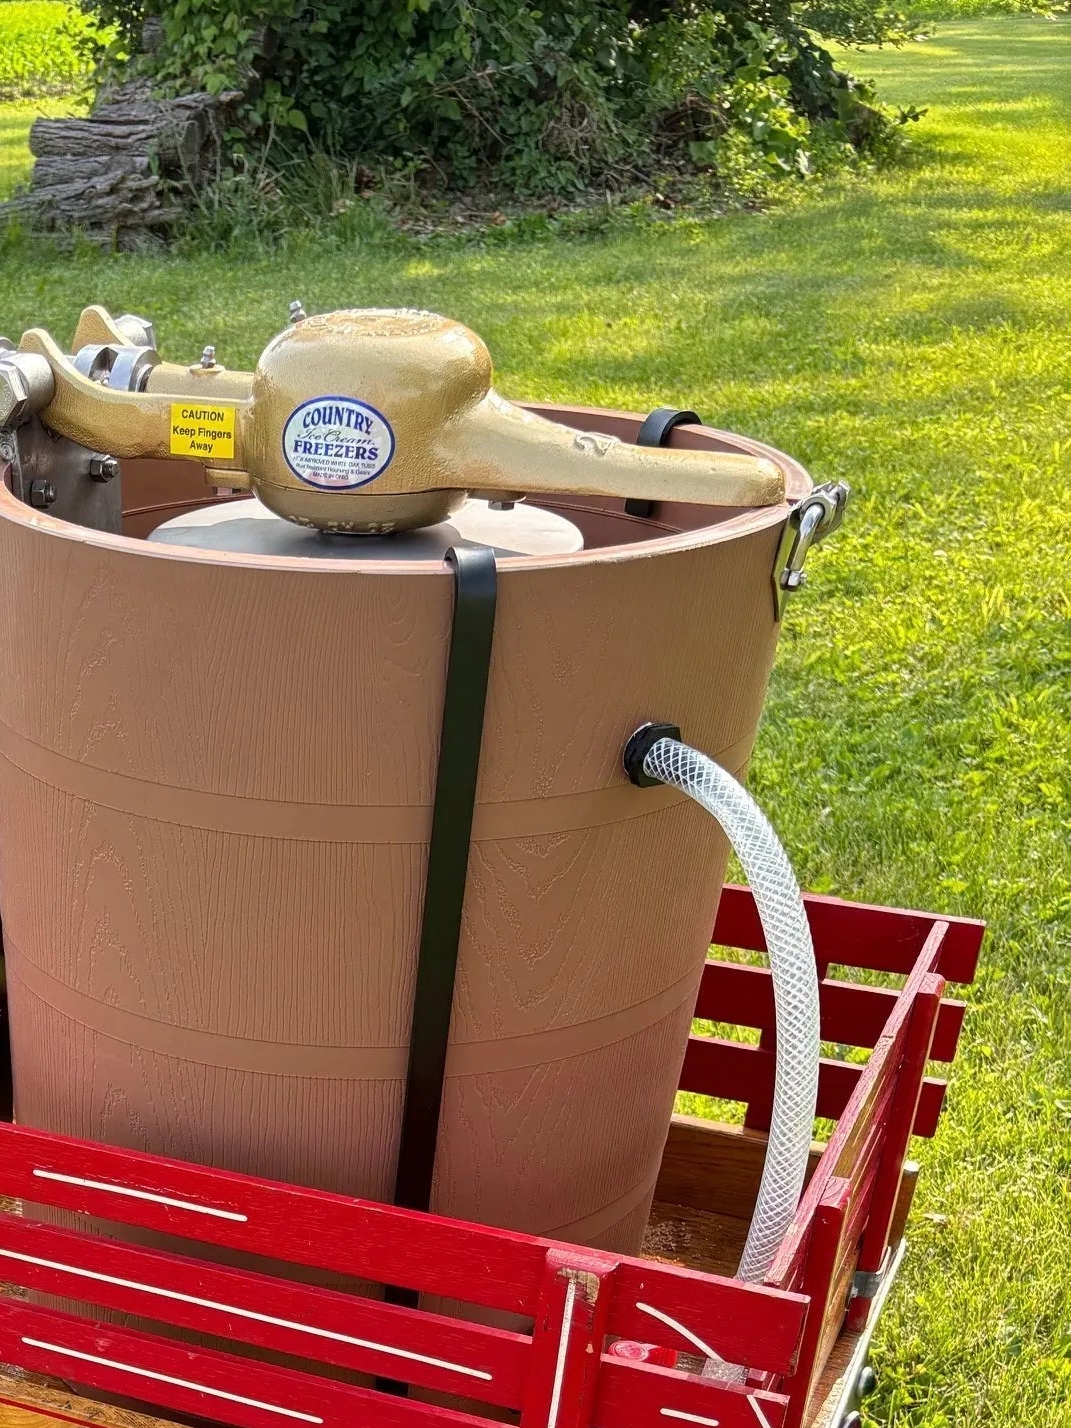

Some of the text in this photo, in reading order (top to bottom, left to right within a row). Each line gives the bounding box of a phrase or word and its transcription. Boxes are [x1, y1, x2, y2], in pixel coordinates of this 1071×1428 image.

[181, 409, 224, 421] CAUTION
[303, 406, 373, 435] COUNTRY
[172, 425, 232, 440] Keep Fingers
[297, 427, 322, 441] Ice
[189, 440, 213, 453] Away
[293, 440, 379, 461] FREEZERS
